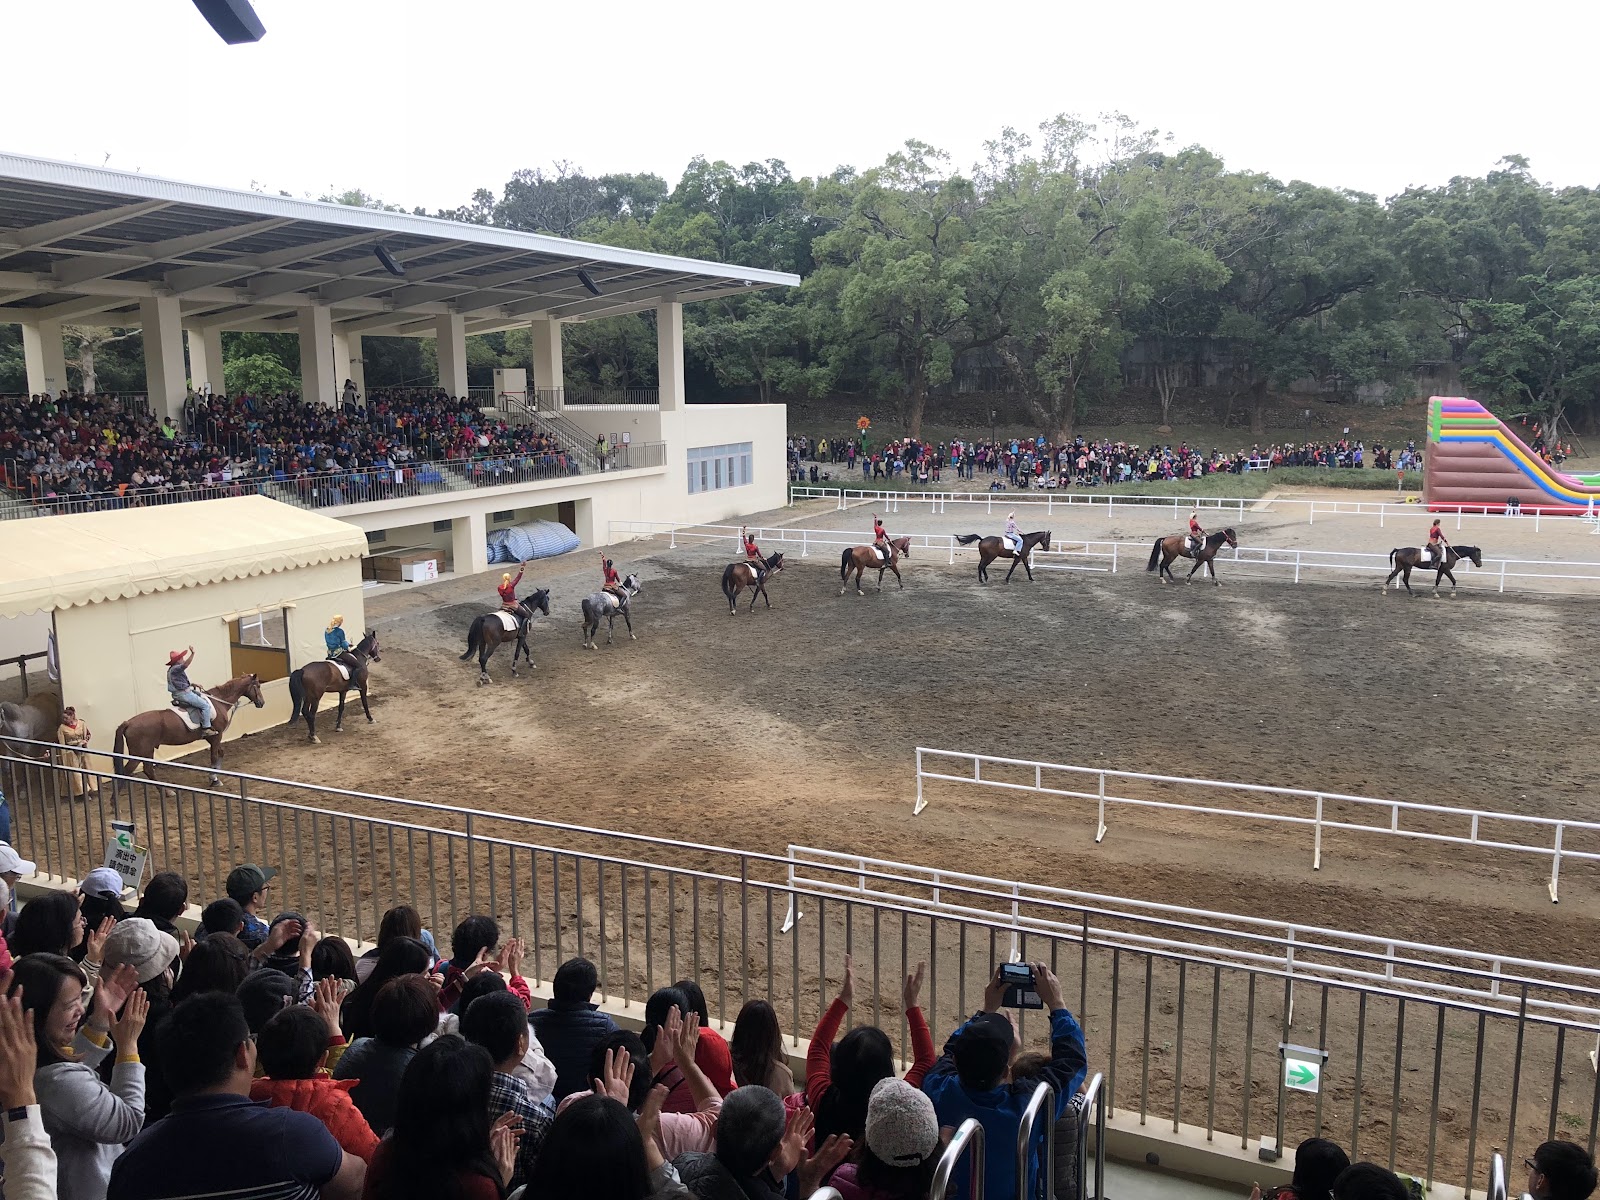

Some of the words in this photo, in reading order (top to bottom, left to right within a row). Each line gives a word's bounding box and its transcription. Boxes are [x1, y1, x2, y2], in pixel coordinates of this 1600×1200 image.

[428, 562, 434, 570] 2
[115, 849, 137, 863] 演出中
